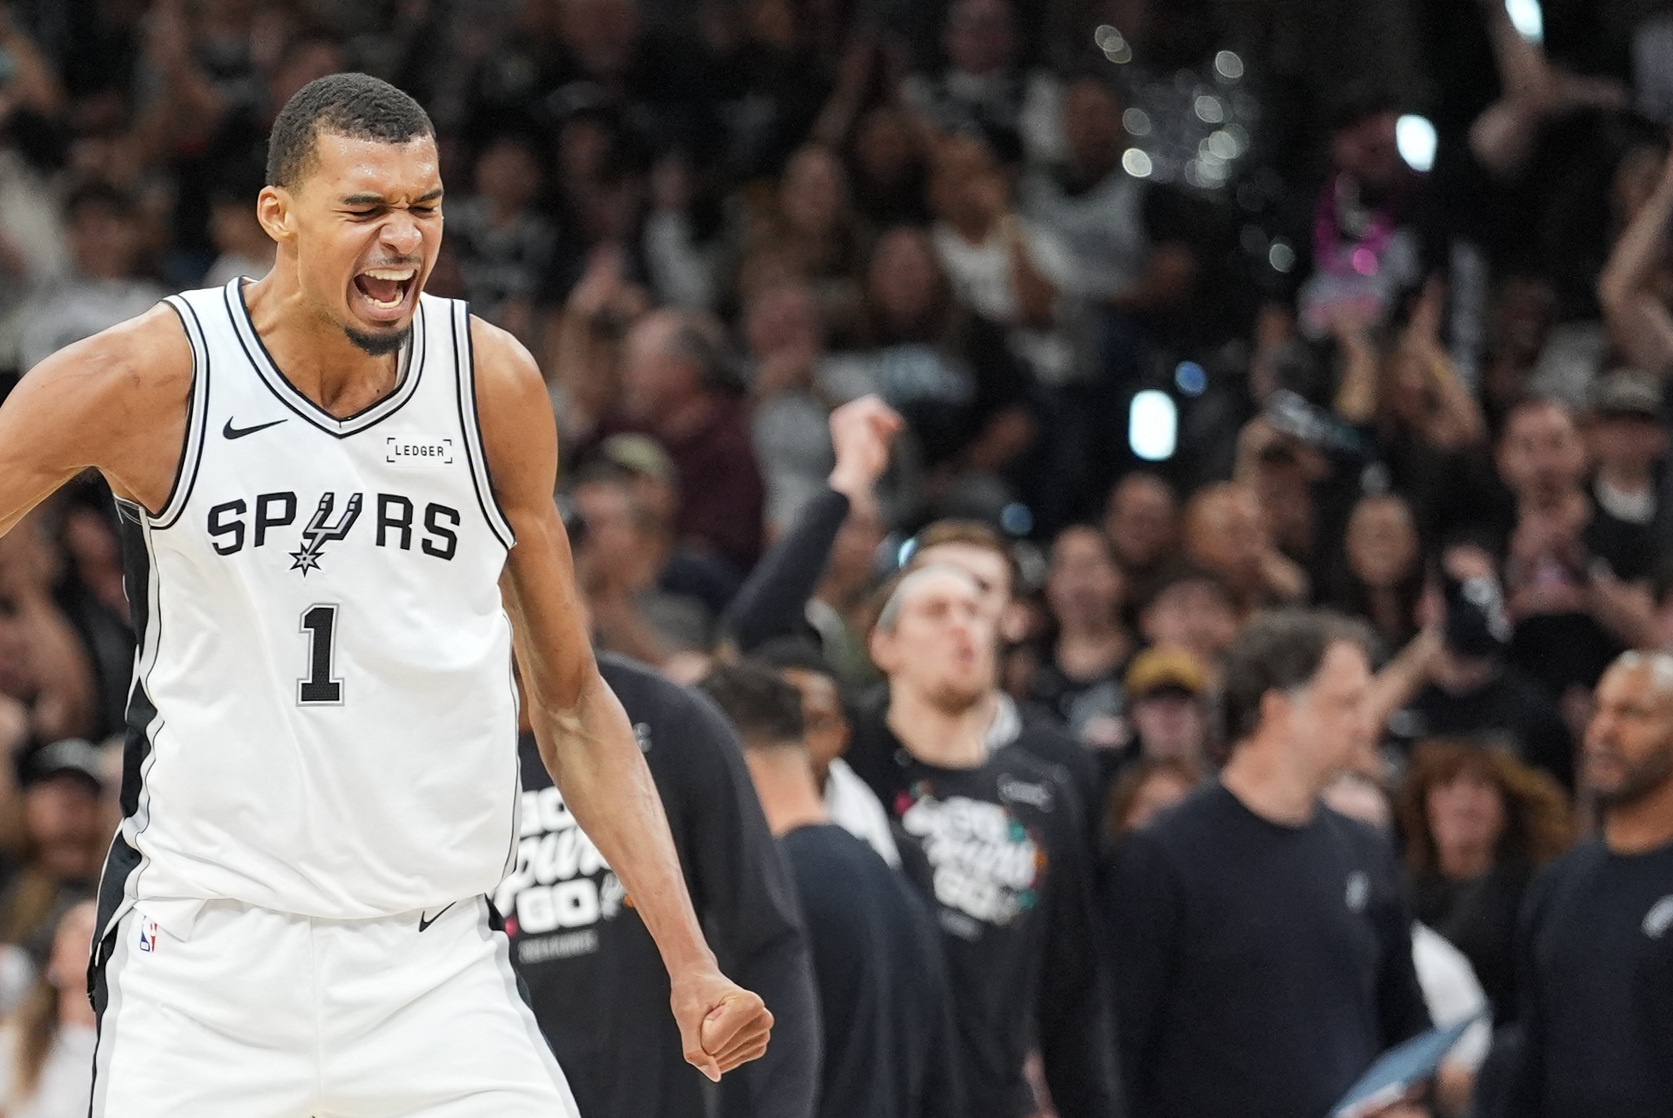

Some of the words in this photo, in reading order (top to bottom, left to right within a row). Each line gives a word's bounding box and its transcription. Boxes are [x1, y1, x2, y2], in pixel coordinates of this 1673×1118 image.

[395, 445, 444, 457] LEDGER
[208, 491, 460, 577] SPURS
[296, 603, 345, 707] 1
[516, 878, 599, 934] GO
